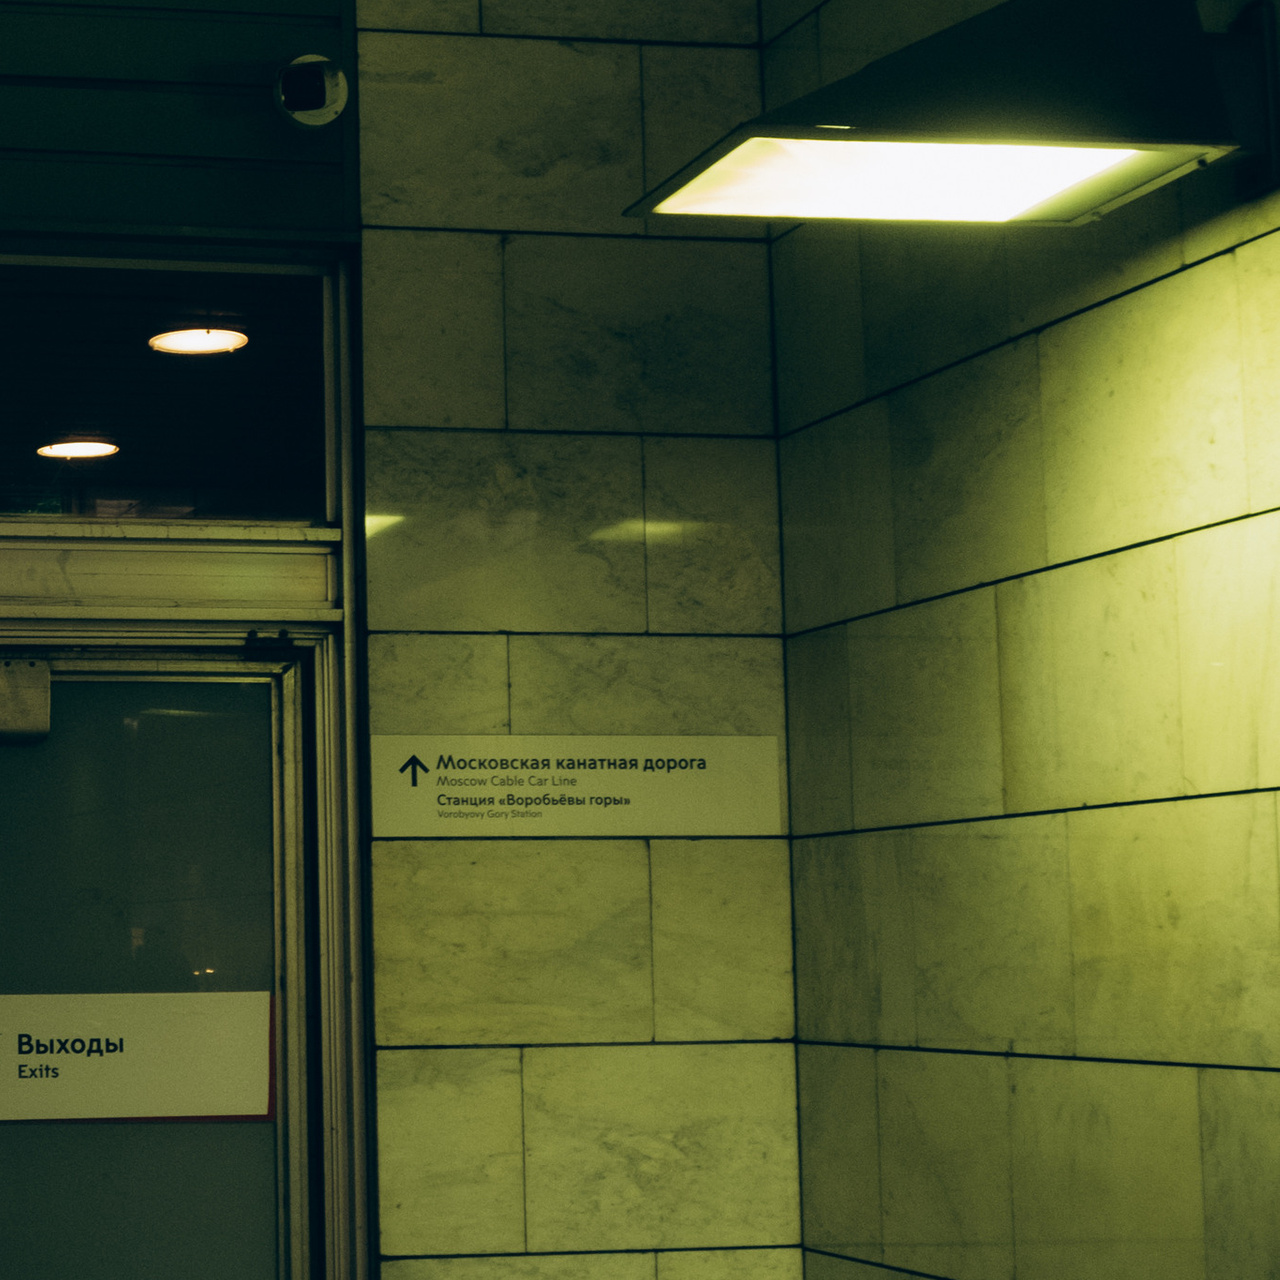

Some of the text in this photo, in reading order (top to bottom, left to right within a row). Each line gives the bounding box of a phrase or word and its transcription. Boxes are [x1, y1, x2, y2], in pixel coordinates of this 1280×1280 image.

[436, 755, 706, 773] Московская канатная дорога
[436, 775, 577, 787] Moscow Cable Car Line
[437, 793, 631, 808] Станция «Воробьёвы горы»
[486, 809, 509, 819] Gory
[510, 809, 543, 818] Station
[18, 1033, 123, 1057] Выходы
[18, 1064, 59, 1079] Exits
